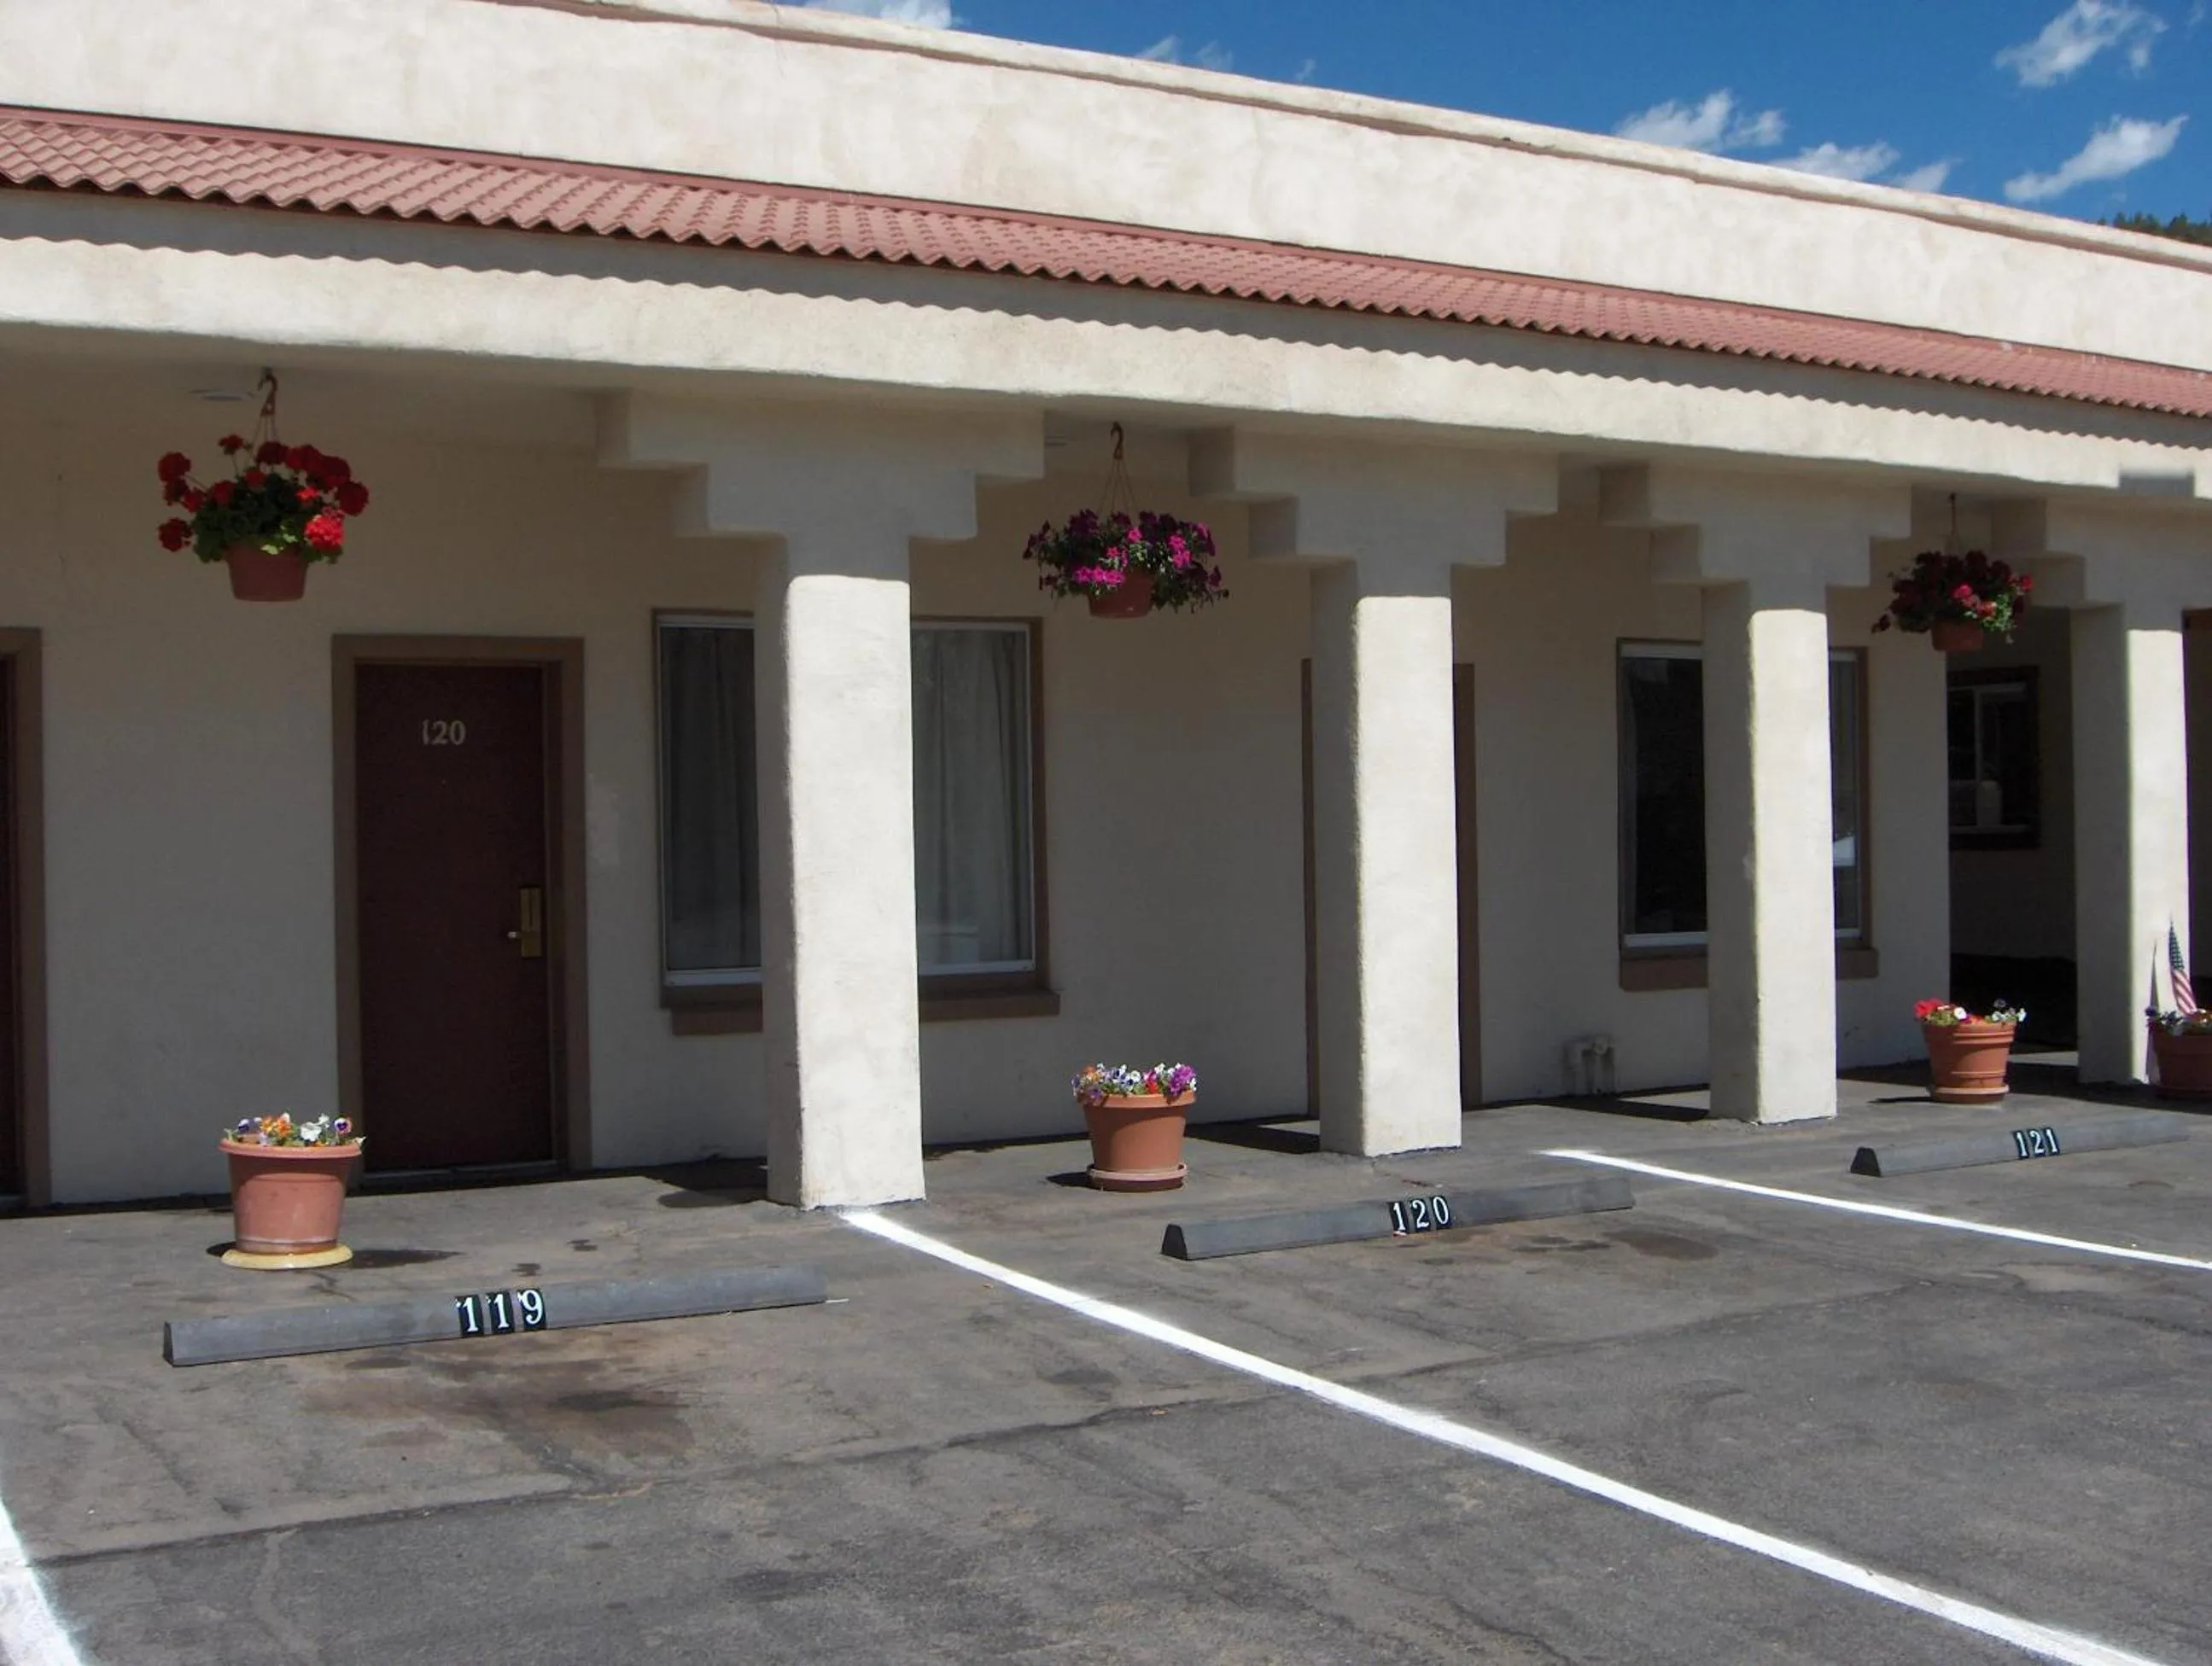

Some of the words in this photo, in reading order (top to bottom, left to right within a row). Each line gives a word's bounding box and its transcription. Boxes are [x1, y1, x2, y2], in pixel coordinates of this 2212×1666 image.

[422, 719, 466, 745] 120
[2016, 1128, 2058, 1157] 121
[1392, 1195, 1450, 1235] 120
[455, 1289, 544, 1333] 119
